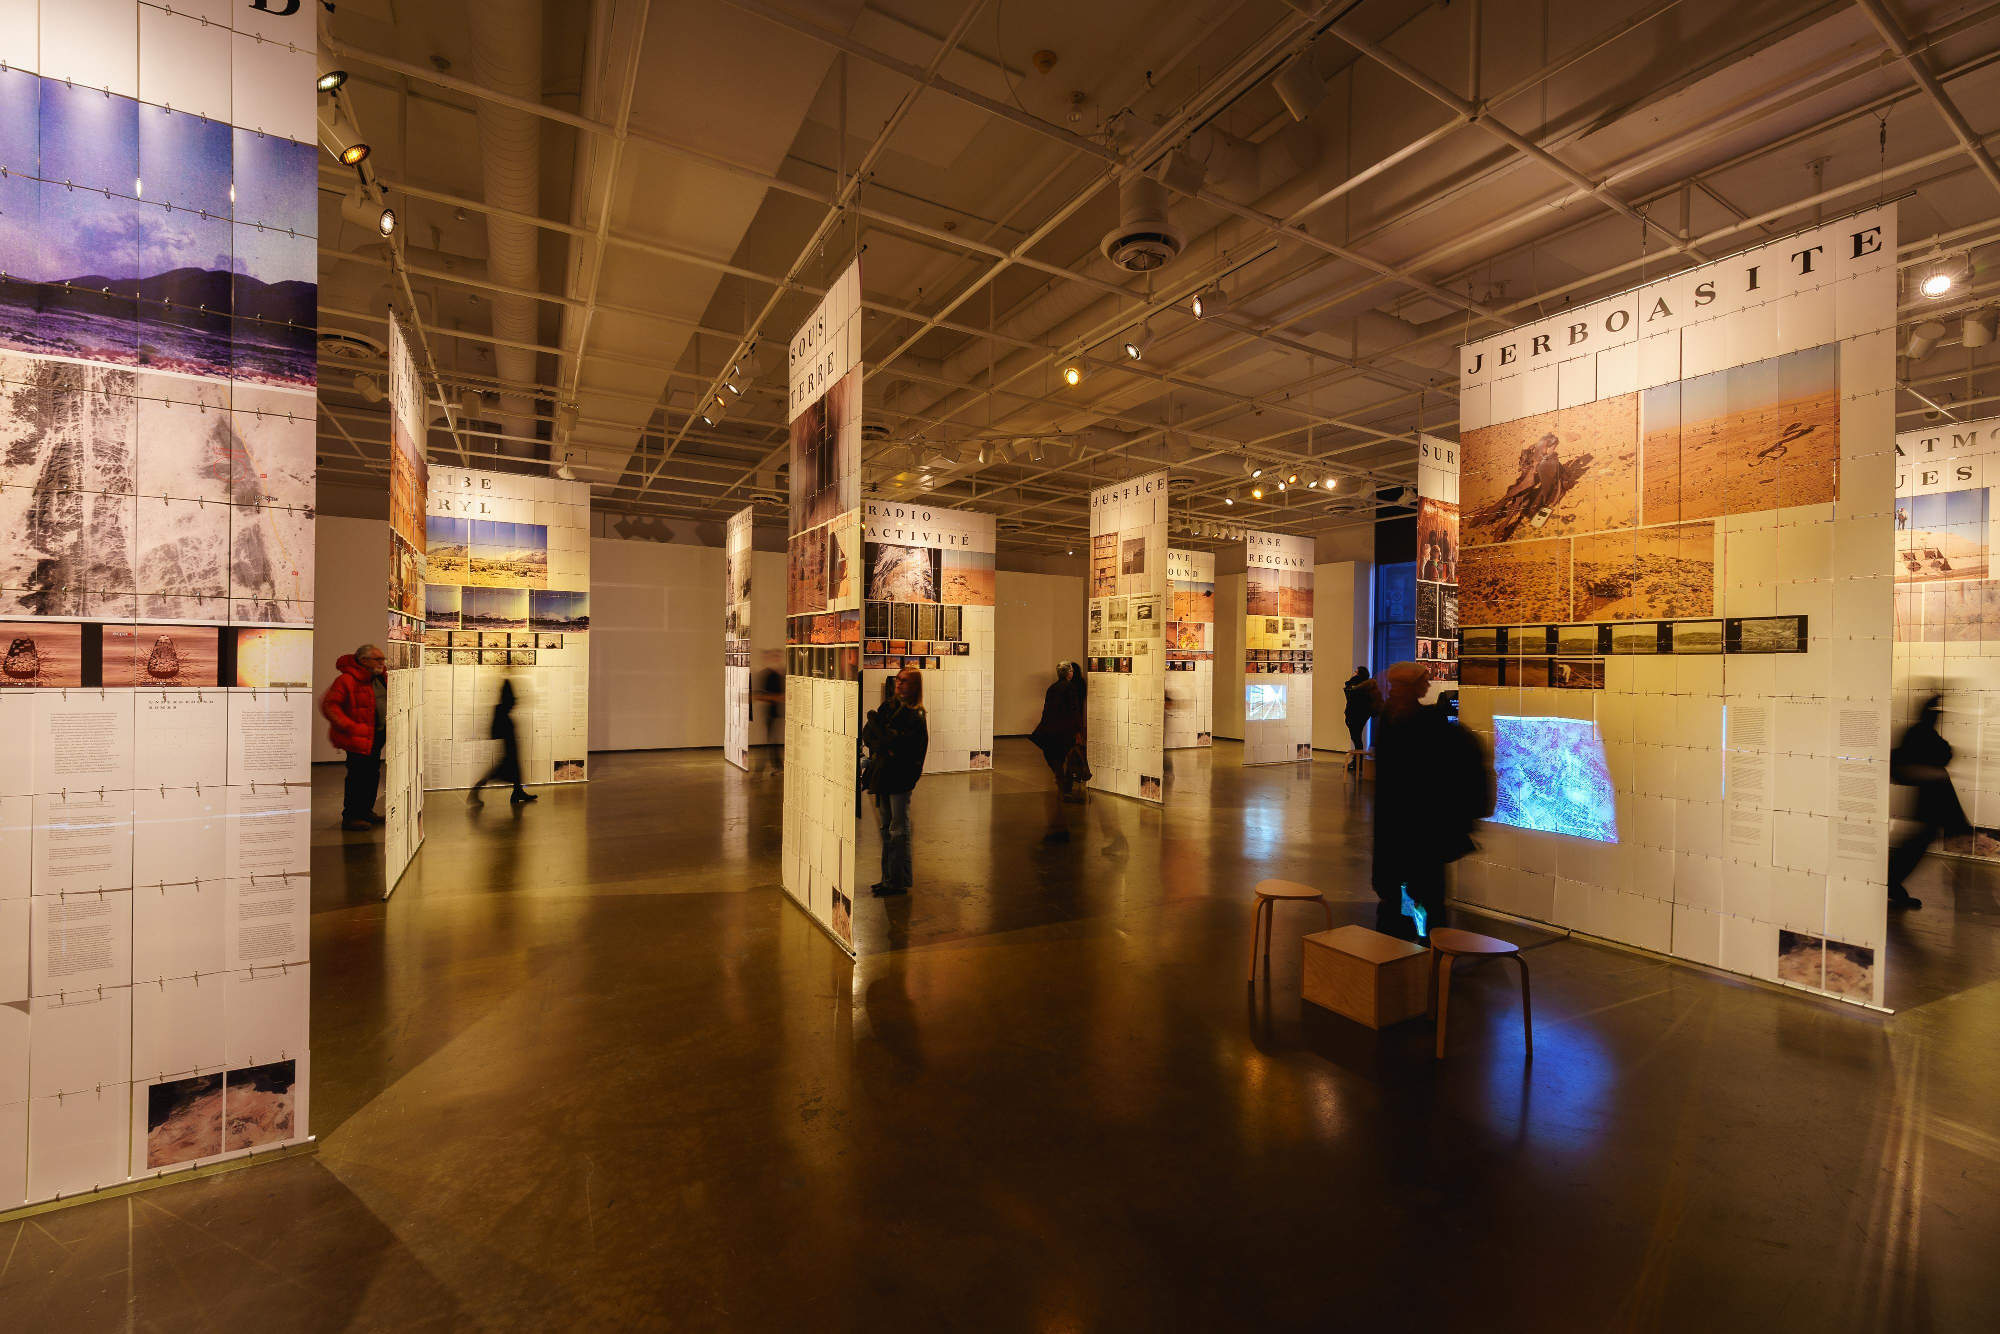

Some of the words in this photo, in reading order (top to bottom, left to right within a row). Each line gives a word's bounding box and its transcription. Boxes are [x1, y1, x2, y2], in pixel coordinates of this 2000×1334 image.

[1467, 226, 1882, 375] JERBOASITE
[790, 316, 823, 367] SOUS
[790, 351, 834, 410] TERRE
[1422, 443, 1455, 465] SUR
[1092, 478, 1165, 508] JUSTICE
[868, 505, 942, 522] RADIO-
[867, 527, 969, 546] ACTIVITÉ
[1249, 535, 1281, 547] BASE
[1248, 553, 1305, 567] REGGANE
